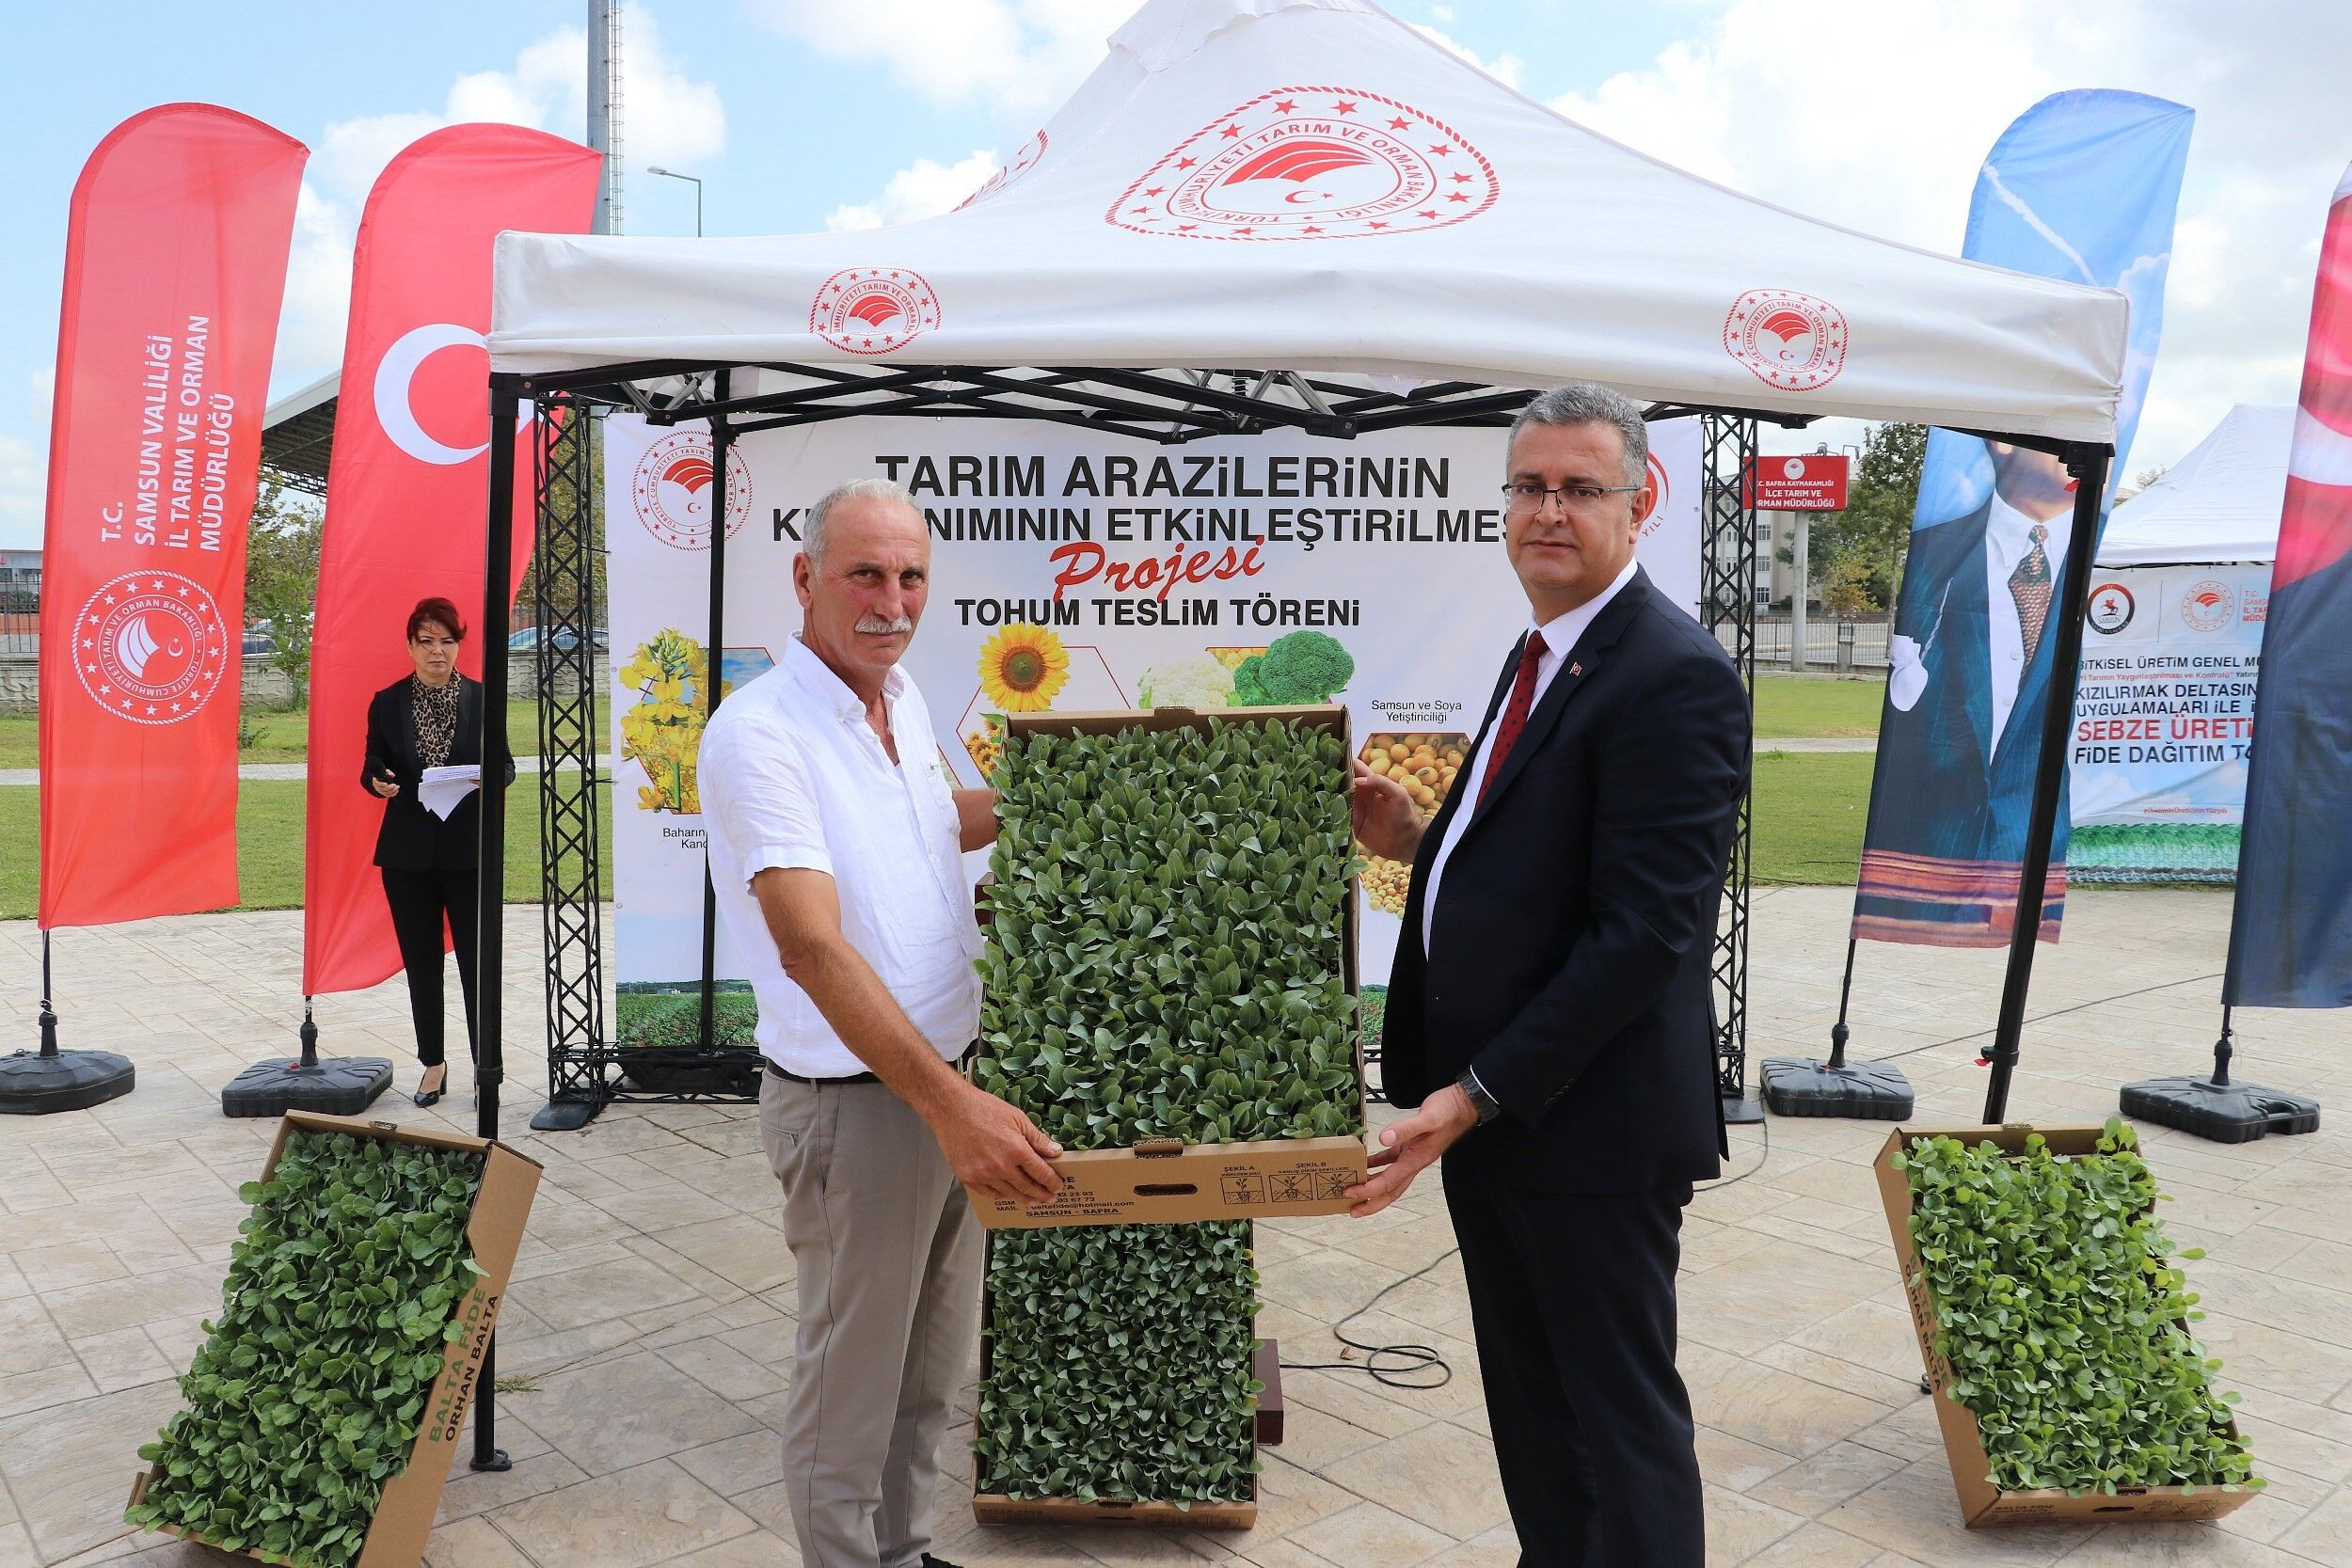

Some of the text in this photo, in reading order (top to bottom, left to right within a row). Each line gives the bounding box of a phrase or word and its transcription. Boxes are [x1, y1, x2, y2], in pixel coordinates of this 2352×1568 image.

[1256, 122, 1332, 144] TARIM
[1342, 127, 1370, 141] VE
[1371, 139, 1424, 179] ORMAN
[862, 283, 890, 292] TARIM
[891, 287, 901, 296] VE
[901, 295, 917, 324] ORMAN
[1776, 301, 1802, 310] TARIM
[1804, 307, 1813, 318] VE
[1812, 316, 1825, 345] ORMAN
[135, 335, 173, 546] SAMSUN VALİLİĞİ
[164, 315, 210, 548] İL TARIM VE ORMAN
[197, 392, 234, 552] MÜDÜRLÜĞÜ
[875, 455, 1045, 498] TARIM
[1765, 488, 1822, 499] İLÇE TARIM VE
[1783, 498, 1836, 508] MÜDÜRLÜĞÜ
[101, 500, 124, 543] T.C.
[772, 508, 1091, 542] KNIMININ
[1642, 515, 1664, 537] YILI
[1049, 535, 1265, 603] Projesi
[103, 629, 115, 658] TARIM
[109, 613, 123, 626] VE
[121, 598, 160, 616] ORMAN
[163, 600, 203, 642] BAKANLIĞI
[954, 598, 1081, 626] TOHUM
[2192, 657, 2241, 668] GENEL
[1372, 700, 1462, 712] Samsun ve Soya
[2076, 683, 2257, 700] KIZILIRMAK DELTASIN
[2076, 700, 2208, 717] UYGULAMALARI
[1386, 712, 1448, 724] Yetiştiriciliği
[2077, 719, 2161, 742] SEBZE
[2129, 741, 2225, 764] DAĞITIM
[662, 828, 706, 838] Baharın
[1905, 1263, 1942, 1392] OHAN BALTA
[445, 1295, 499, 1442] ORHAN BALTA
[428, 1359, 465, 1443] BALTA
